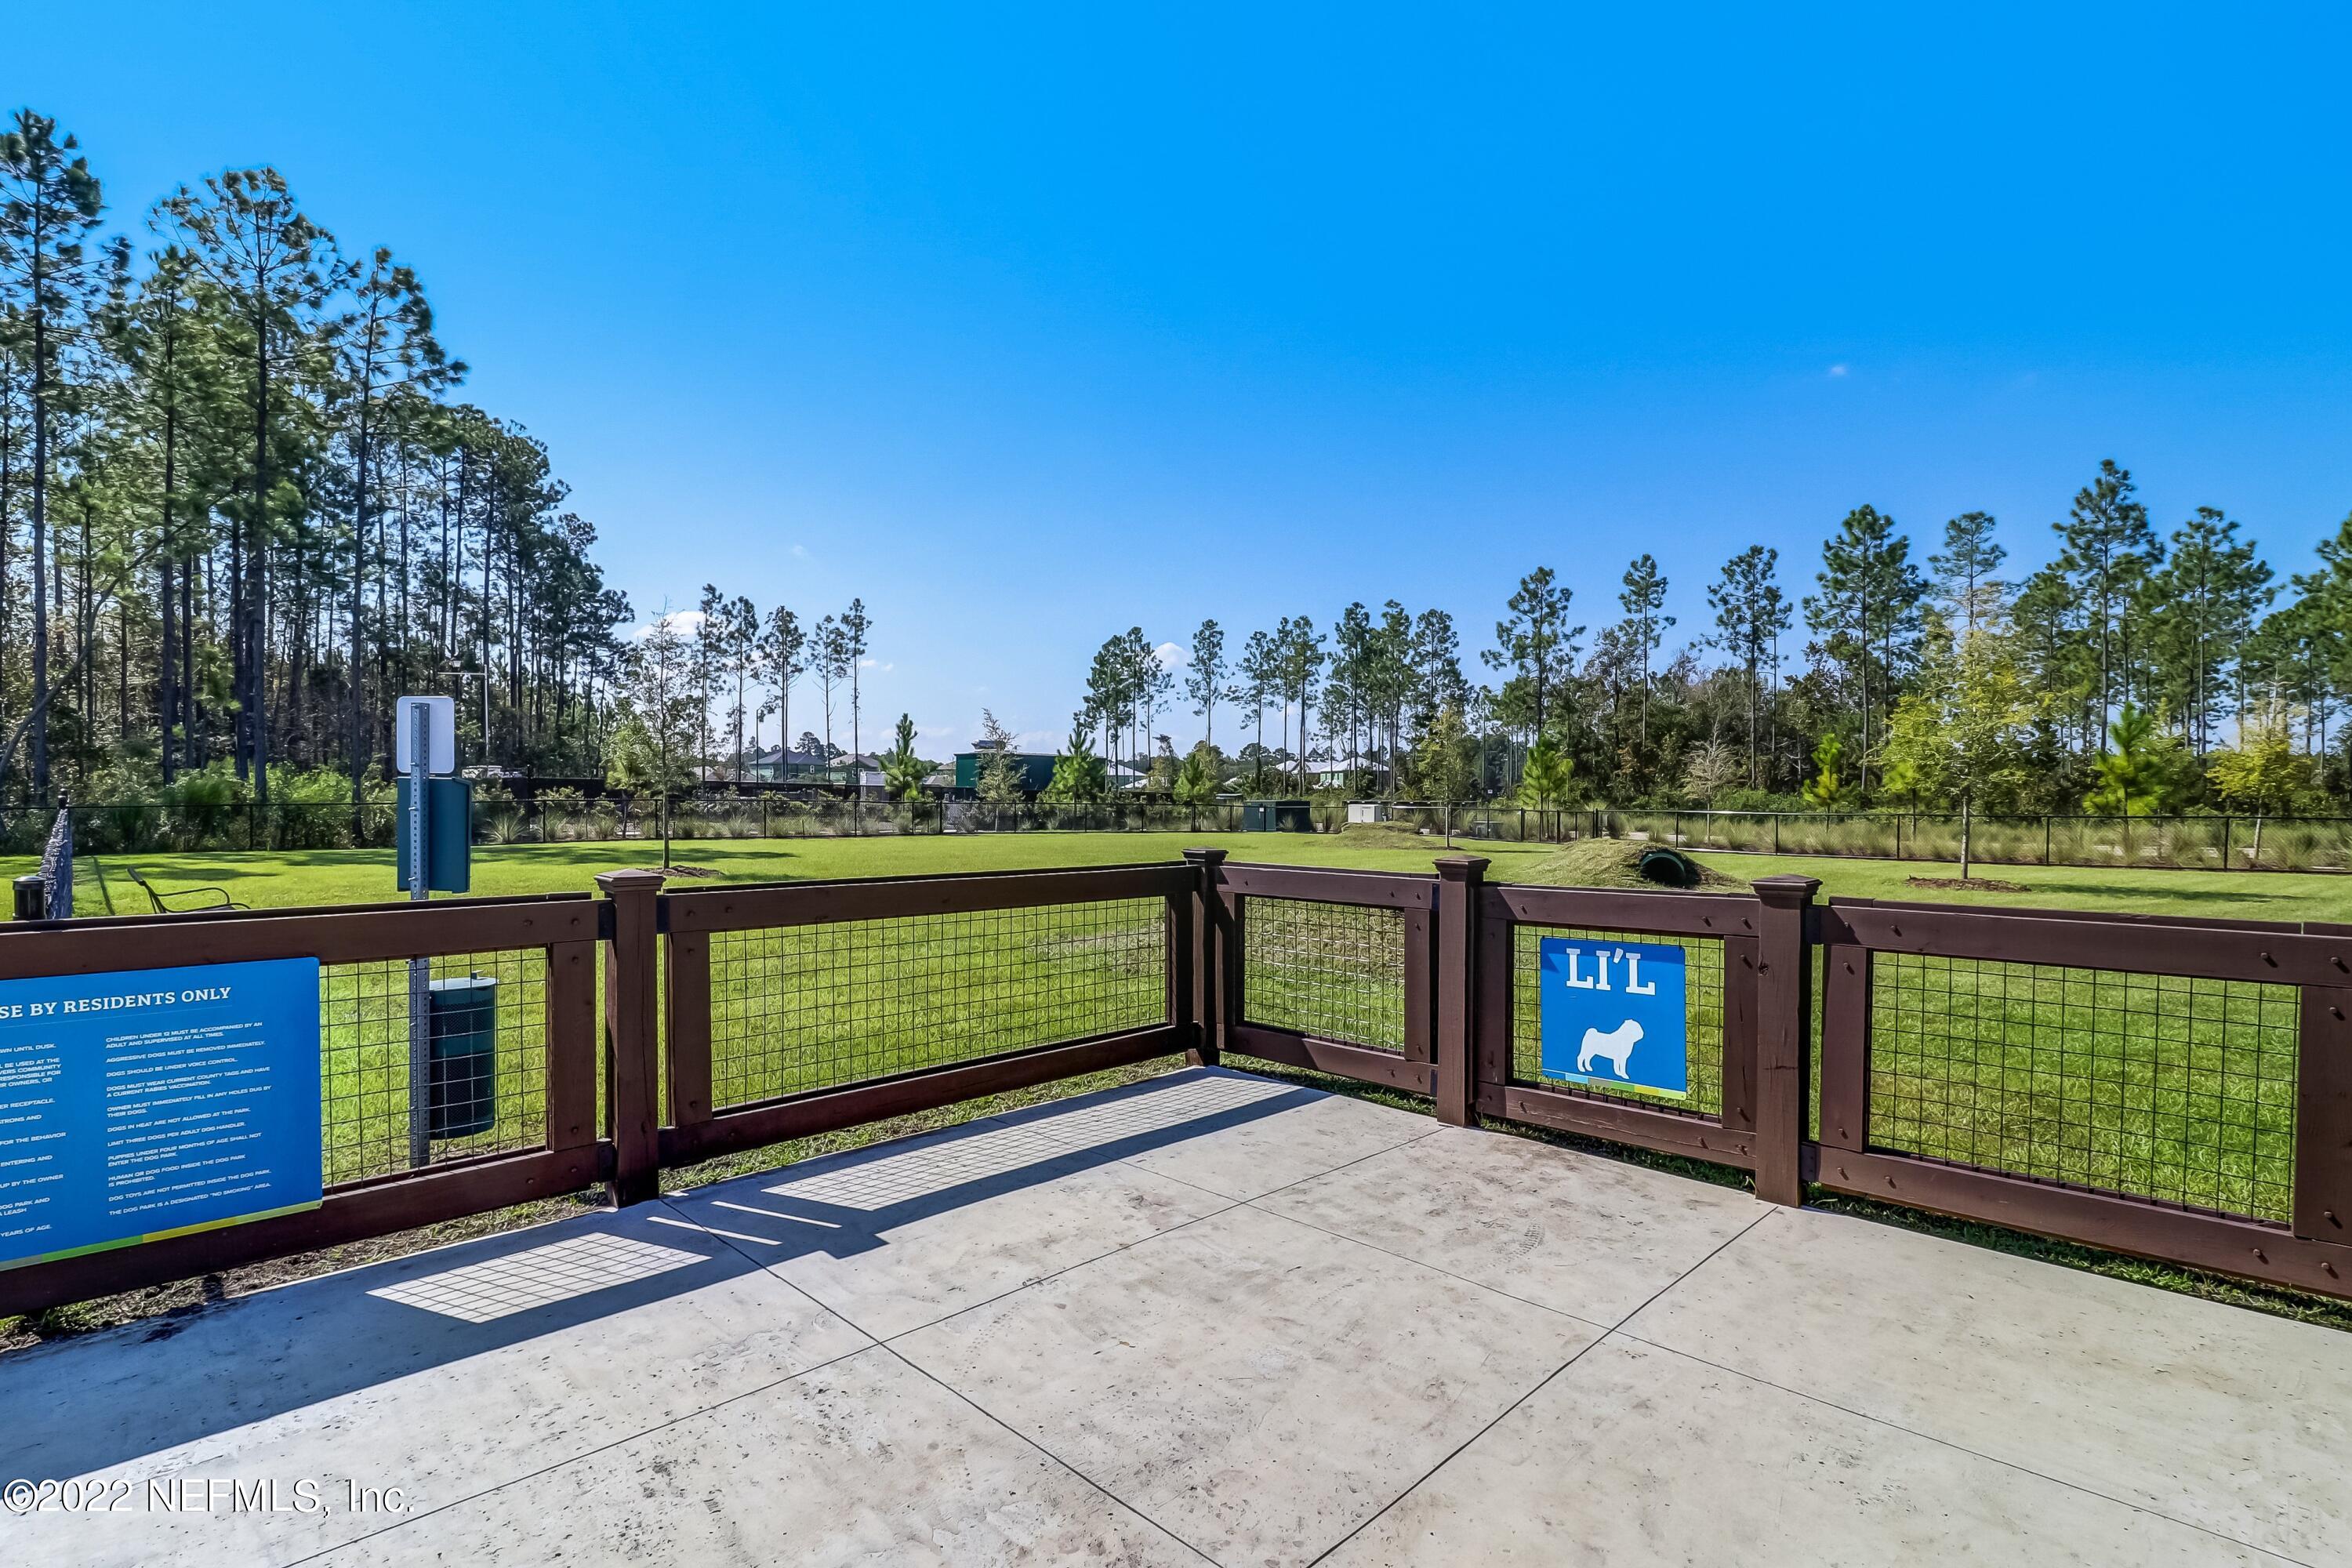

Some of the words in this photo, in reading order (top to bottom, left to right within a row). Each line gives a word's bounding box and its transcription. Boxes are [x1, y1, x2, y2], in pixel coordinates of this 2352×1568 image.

[1566, 947, 1656, 996] LI'L
[30, 1002, 57, 1016] BY
[64, 992, 175, 1013] RESIDENTS
[182, 987, 230, 1002] ONLY
[106, 1054, 147, 1062] AGGRESSIVE
[17, 1064, 61, 1073] COMMUNITY
[166, 1076, 196, 1084] CURRENT
[113, 1088, 143, 1097] CURRENT
[152, 1096, 193, 1105] IMMEDIATELY
[31, 1132, 66, 1141] BEHAVIOR
[1, 1157, 35, 1167] ENTERING
[38, 1174, 64, 1182] OWNER
[171, 1181, 206, 1190] PERMITTED
[170, 1194, 209, 1204] DESIGNATED
